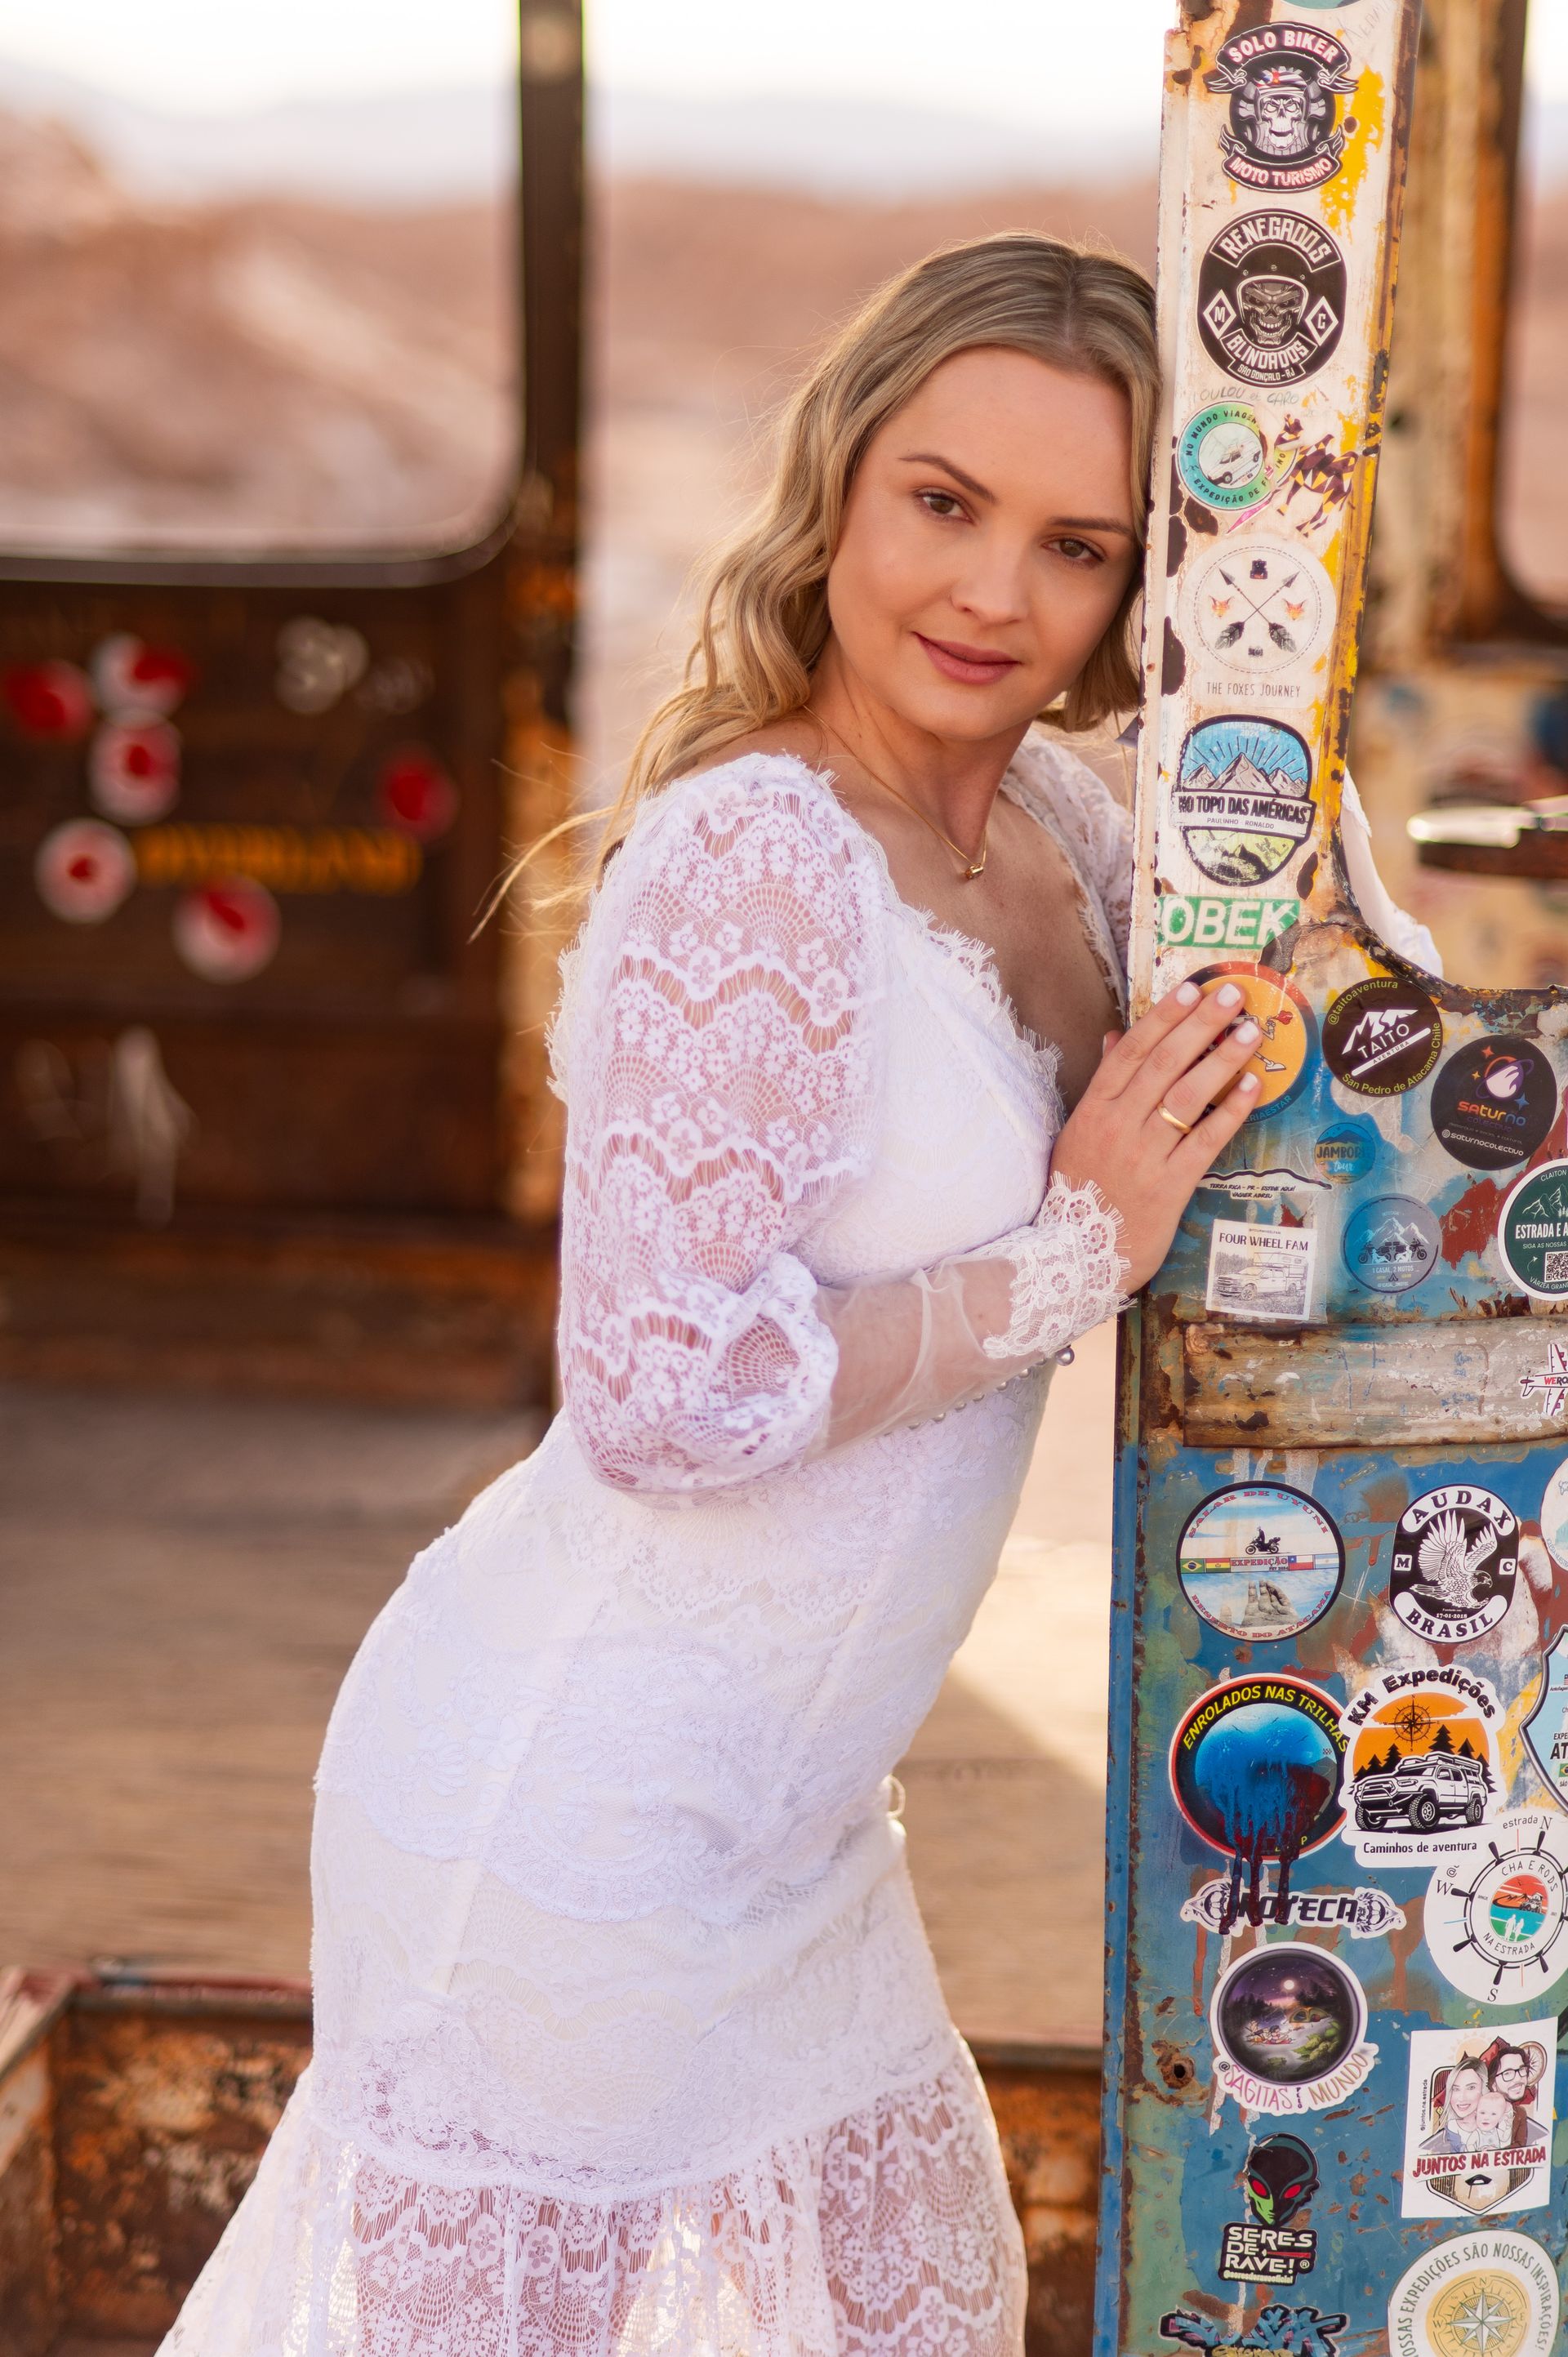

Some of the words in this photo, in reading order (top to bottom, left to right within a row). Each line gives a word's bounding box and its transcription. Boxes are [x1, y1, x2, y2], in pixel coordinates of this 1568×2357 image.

[1228, 31, 1276, 63] SOLO
[1285, 30, 1339, 63] BIKER
[1229, 157, 1268, 185] MOTO
[1272, 158, 1332, 186] TURISMO
[1221, 216, 1332, 264] RENEGADOS
[1214, 306, 1226, 323] M
[1317, 313, 1327, 330] C
[1227, 333, 1309, 370] BLINDADOS
[1237, 363, 1250, 377] SÃO
[1251, 371, 1281, 383] GONÇALO
[1286, 367, 1295, 377] RJ
[1186, 443, 1194, 457] NO
[1191, 413, 1218, 439] MUNDO
[1193, 479, 1244, 505] EXPEDIÇÃO
[1248, 487, 1260, 499] DE
[1207, 682, 1223, 695] THE
[1227, 682, 1255, 696] FOXES
[1260, 684, 1301, 697] JOURNEY
[1196, 795, 1224, 814] TOPO
[1227, 797, 1250, 816] DAS
[1250, 799, 1307, 825] AMÉRICAS
[1207, 818, 1239, 826] PAULINHO
[1245, 821, 1275, 830] RONALDO
[1328, 979, 1399, 1026] @taitoaventura
[1357, 1023, 1410, 1058] TAITO
[1373, 1040, 1410, 1064] AVENTURA
[1342, 1073, 1360, 1091] San
[1361, 1082, 1392, 1095] Pedro
[1393, 1081, 1406, 1093] de
[1407, 1047, 1438, 1085] Atacama
[1432, 1022, 1441, 1049] Chile
[1540, 1169, 1567, 1182] CLAITON
[1219, 1232, 1247, 1245] FOUR
[1250, 1236, 1284, 1250] WHEEL
[1285, 1240, 1308, 1251] FAM
[1515, 1223, 1555, 1240] ESTRADA
[1556, 1223, 1561, 1237] E
[1536, 1241, 1544, 1250] AS
[1544, 1241, 1567, 1249] NOSSAS
[1530, 1277, 1549, 1290] VÁRZEA
[1189, 1495, 1236, 1538] SALAR
[1277, 1492, 1329, 1534] UYUNI
[1412, 1490, 1511, 1530] AUDAX
[1231, 1556, 1288, 1567] EXPEDIÇÃO
[1396, 1557, 1410, 1569] M
[1503, 1561, 1512, 1572] C
[1192, 1594, 1247, 1637] DESERTO
[1276, 1590, 1331, 1636] ATACAMA
[1405, 1607, 1493, 1637] BRASIL
[1348, 1691, 1379, 1727] KM
[1382, 1668, 1495, 1718] Expedições
[1183, 1685, 1261, 1751] ENROLADOS
[1265, 1686, 1297, 1702] NAS
[1298, 1695, 1349, 1753] TRILHAS
[1503, 1815, 1538, 1829] estrada
[1539, 1816, 1553, 1832] N
[1363, 1842, 1413, 1854] Caminhos
[1416, 1842, 1429, 1852] de
[1432, 1840, 1477, 1851] aventura
[1436, 1879, 1453, 1896] W
[1501, 1862, 1523, 1877] CHA
[1528, 1860, 1535, 1870] E
[1538, 1864, 1558, 1891] RODS
[1483, 1932, 1494, 1945] NA
[1494, 1942, 1535, 1955] ESTRADA
[1487, 1989, 1499, 2002] S
[1307, 2052, 1369, 2105] MUNDO
[1412, 2154, 1467, 2178] JUNTOS
[1471, 2152, 1489, 2169] NA
[1494, 2145, 1547, 2165] ESTRADA
[1227, 2226, 1312, 2250] SERES
[1227, 2241, 1259, 2256] DE
[1465, 2242, 1489, 2261] SÃO
[1493, 2243, 1535, 2270] NOSSAS
[1225, 2253, 1295, 2275] RAVE!
[1401, 2251, 1460, 2313] EXPEDIÇÕES
[1479, 2277, 1487, 2286] N
[1520, 2312, 1525, 2320] E
[1530, 2262, 1552, 2350] INSPIRAÇÕES!
[1433, 2319, 1444, 2328] W
[1398, 2317, 1418, 2357] OSSAS
